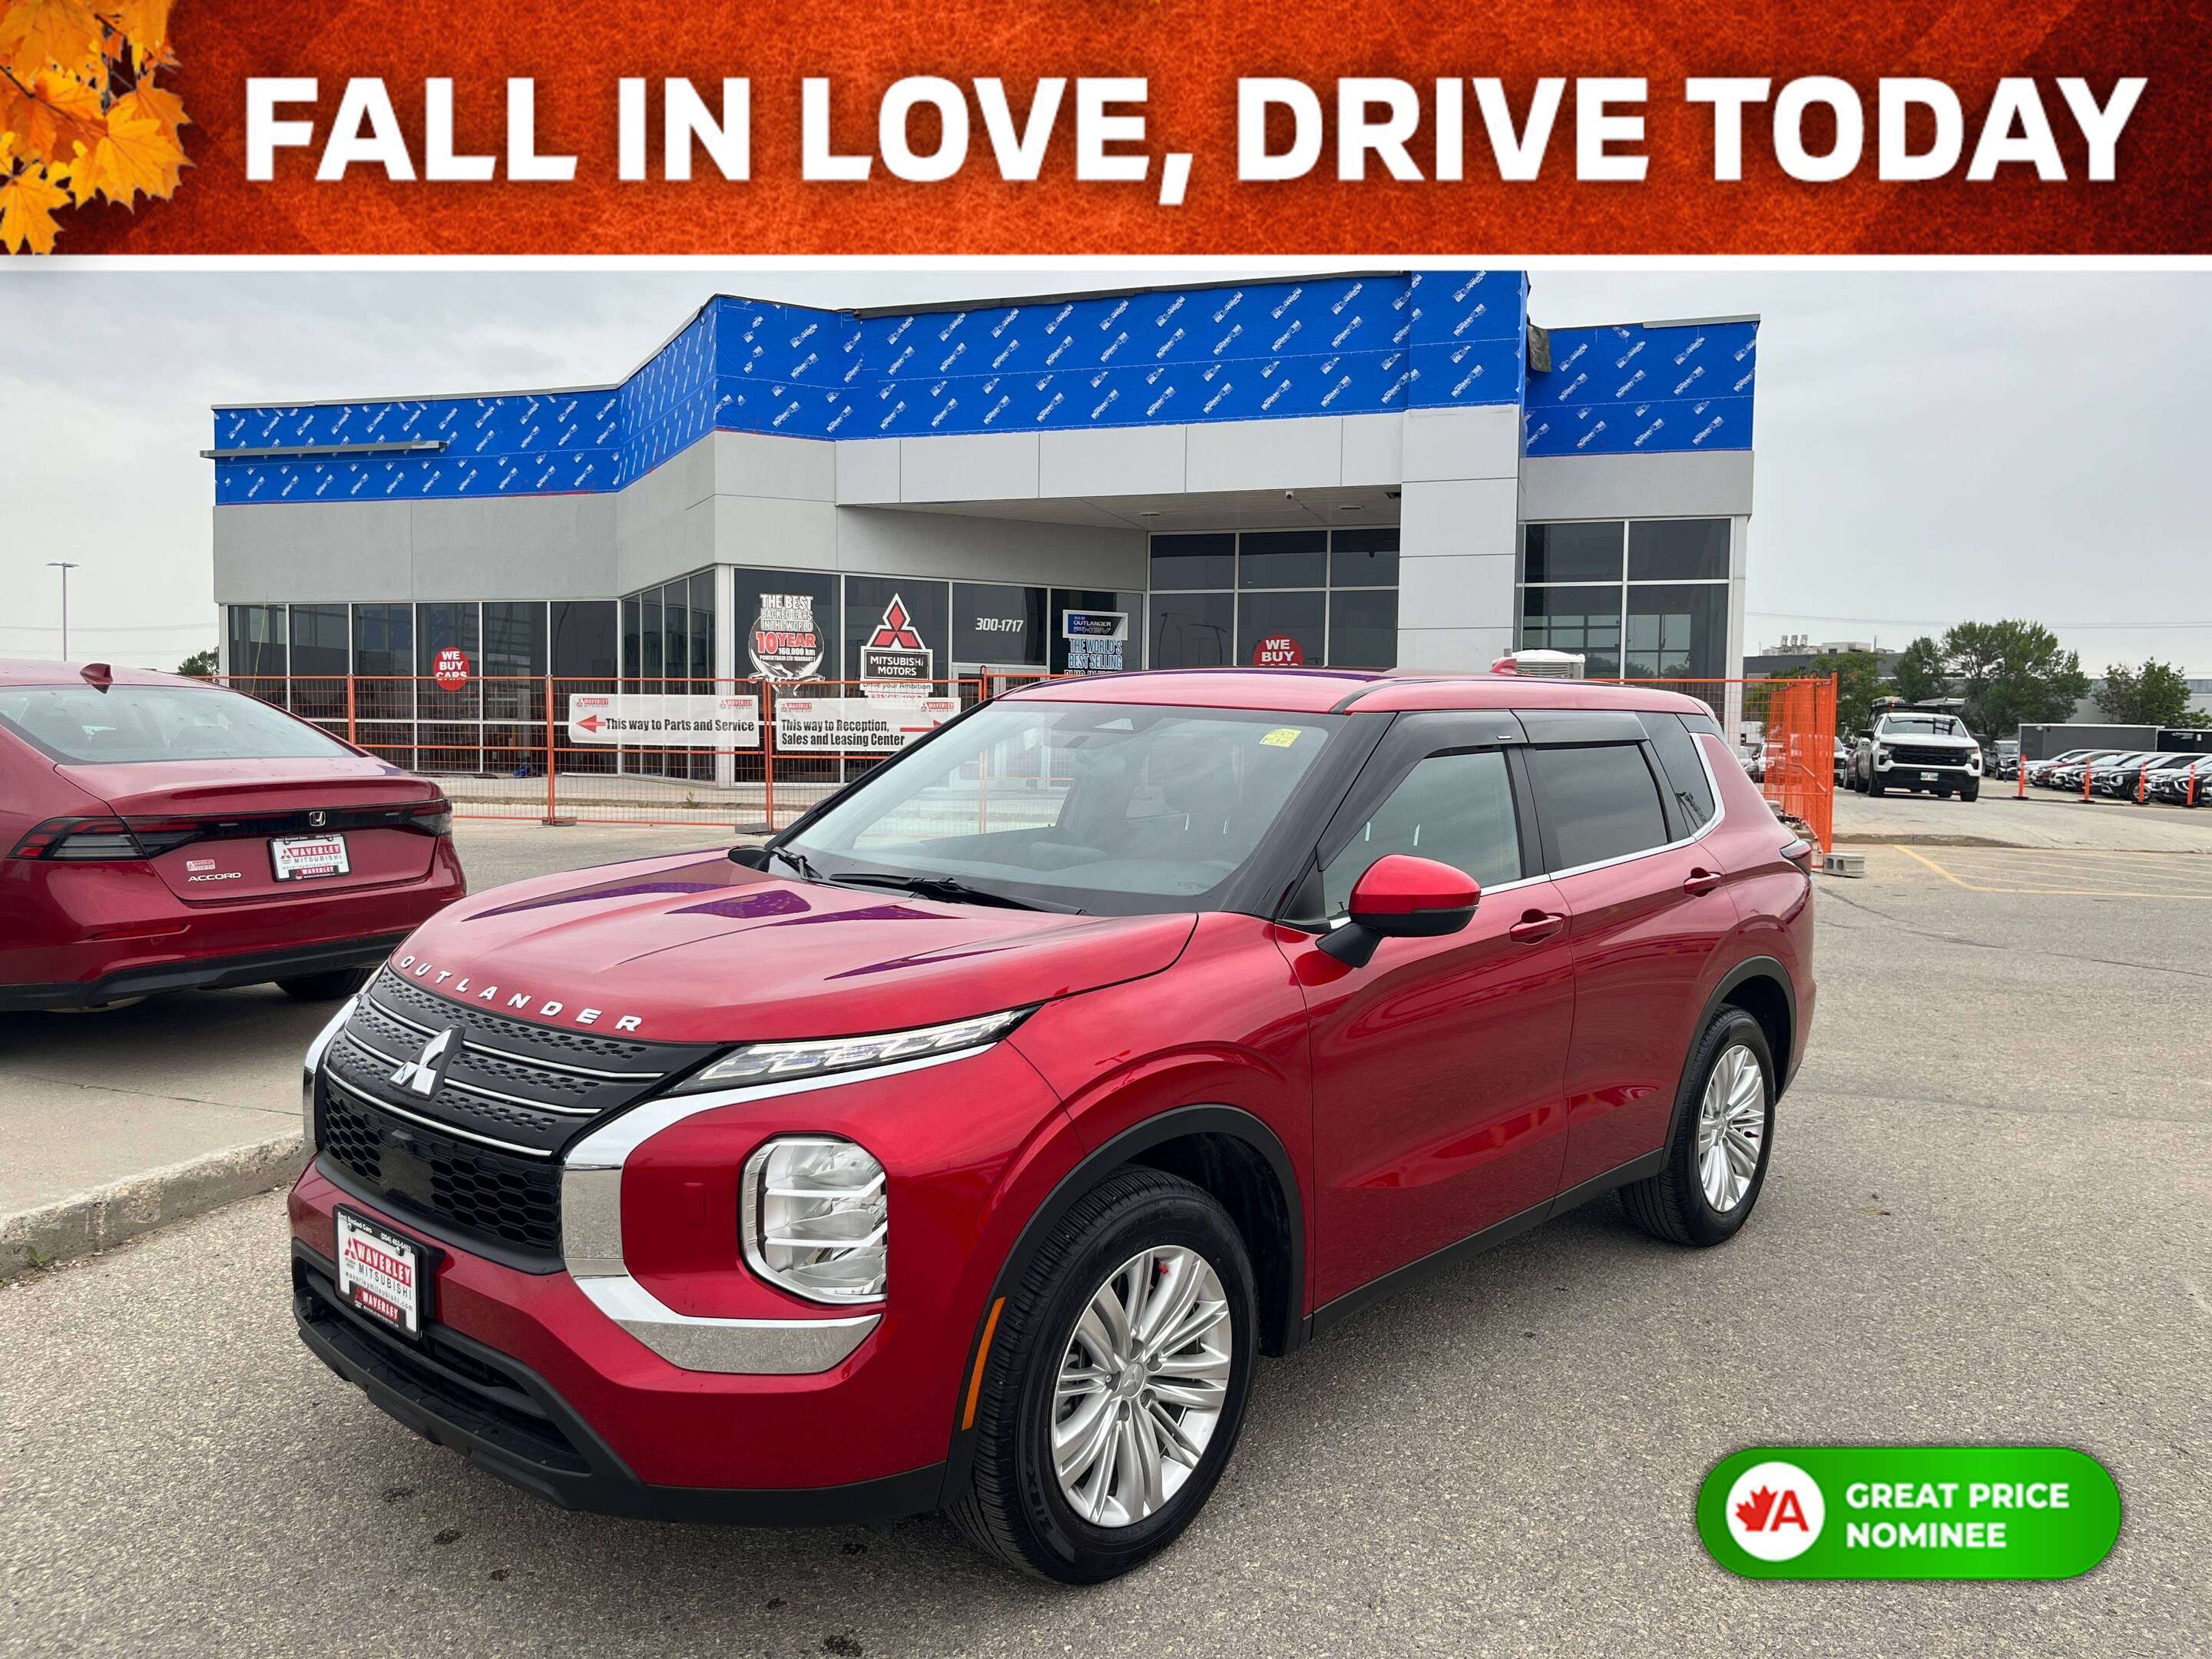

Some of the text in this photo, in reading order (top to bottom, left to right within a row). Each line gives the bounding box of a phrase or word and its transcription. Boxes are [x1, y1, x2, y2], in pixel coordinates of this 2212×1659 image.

[760, 594, 813, 611] THE BEST
[792, 610, 813, 621] CARS
[786, 621, 813, 631] WORLD
[975, 618, 1024, 632] 300-1717
[756, 631, 816, 654] 10 YEAR
[1069, 638, 1123, 654] THE WORLD'S
[1266, 639, 1290, 650] WE
[442, 651, 461, 661] WE
[870, 656, 924, 667] MITSUBISHI
[1068, 653, 1123, 670] BEST SELLING
[1261, 651, 1295, 662] BUY
[439, 661, 464, 671] BUY
[878, 666, 917, 676] MOTORS
[435, 671, 468, 681] CARS
[605, 718, 754, 731] This way to Parts and Service
[781, 719, 889, 733] This way to Reception,
[782, 733, 906, 747] Sales and Leasing Center
[292, 845, 339, 856] WAVERLEY
[294, 854, 342, 863] MITSUBISHI
[302, 866, 334, 875] WAVERLEY
[187, 872, 242, 882] ACCORD
[399, 955, 643, 1032] OUTLANDER
[362, 1224, 373, 1233] Cars
[356, 1241, 411, 1284] WAVERLEY
[359, 1263, 412, 1300] MITSUBISHI
[363, 1290, 399, 1320] WAVERLEY
